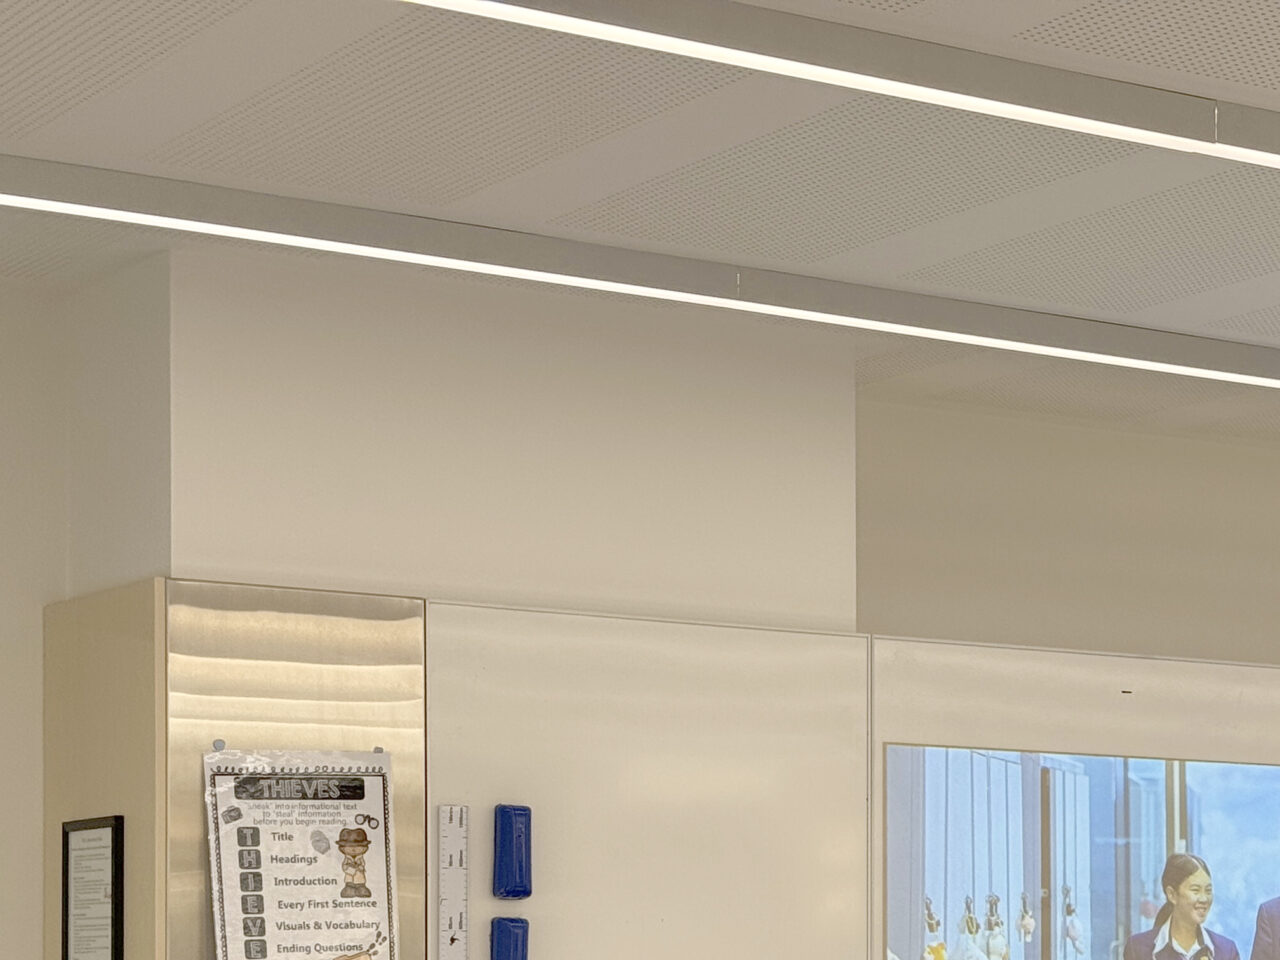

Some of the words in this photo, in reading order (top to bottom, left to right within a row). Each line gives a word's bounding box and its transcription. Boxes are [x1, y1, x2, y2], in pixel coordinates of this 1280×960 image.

[259, 779, 340, 798] THIEVES
[243, 829, 254, 846] T
[271, 832, 294, 842] Title
[243, 851, 257, 868] H
[270, 854, 318, 866] Headings
[274, 876, 338, 887] Introduction
[247, 896, 259, 913] E
[278, 900, 305, 911] Every
[308, 900, 329, 909] First
[332, 899, 377, 908] Sentence
[247, 919, 262, 936] V
[276, 921, 310, 931] Visuals
[313, 921, 322, 930] &
[325, 920, 381, 931] Vocabulary
[251, 942, 261, 958] E
[277, 944, 311, 955] Ending
[314, 943, 363, 953] Questions
